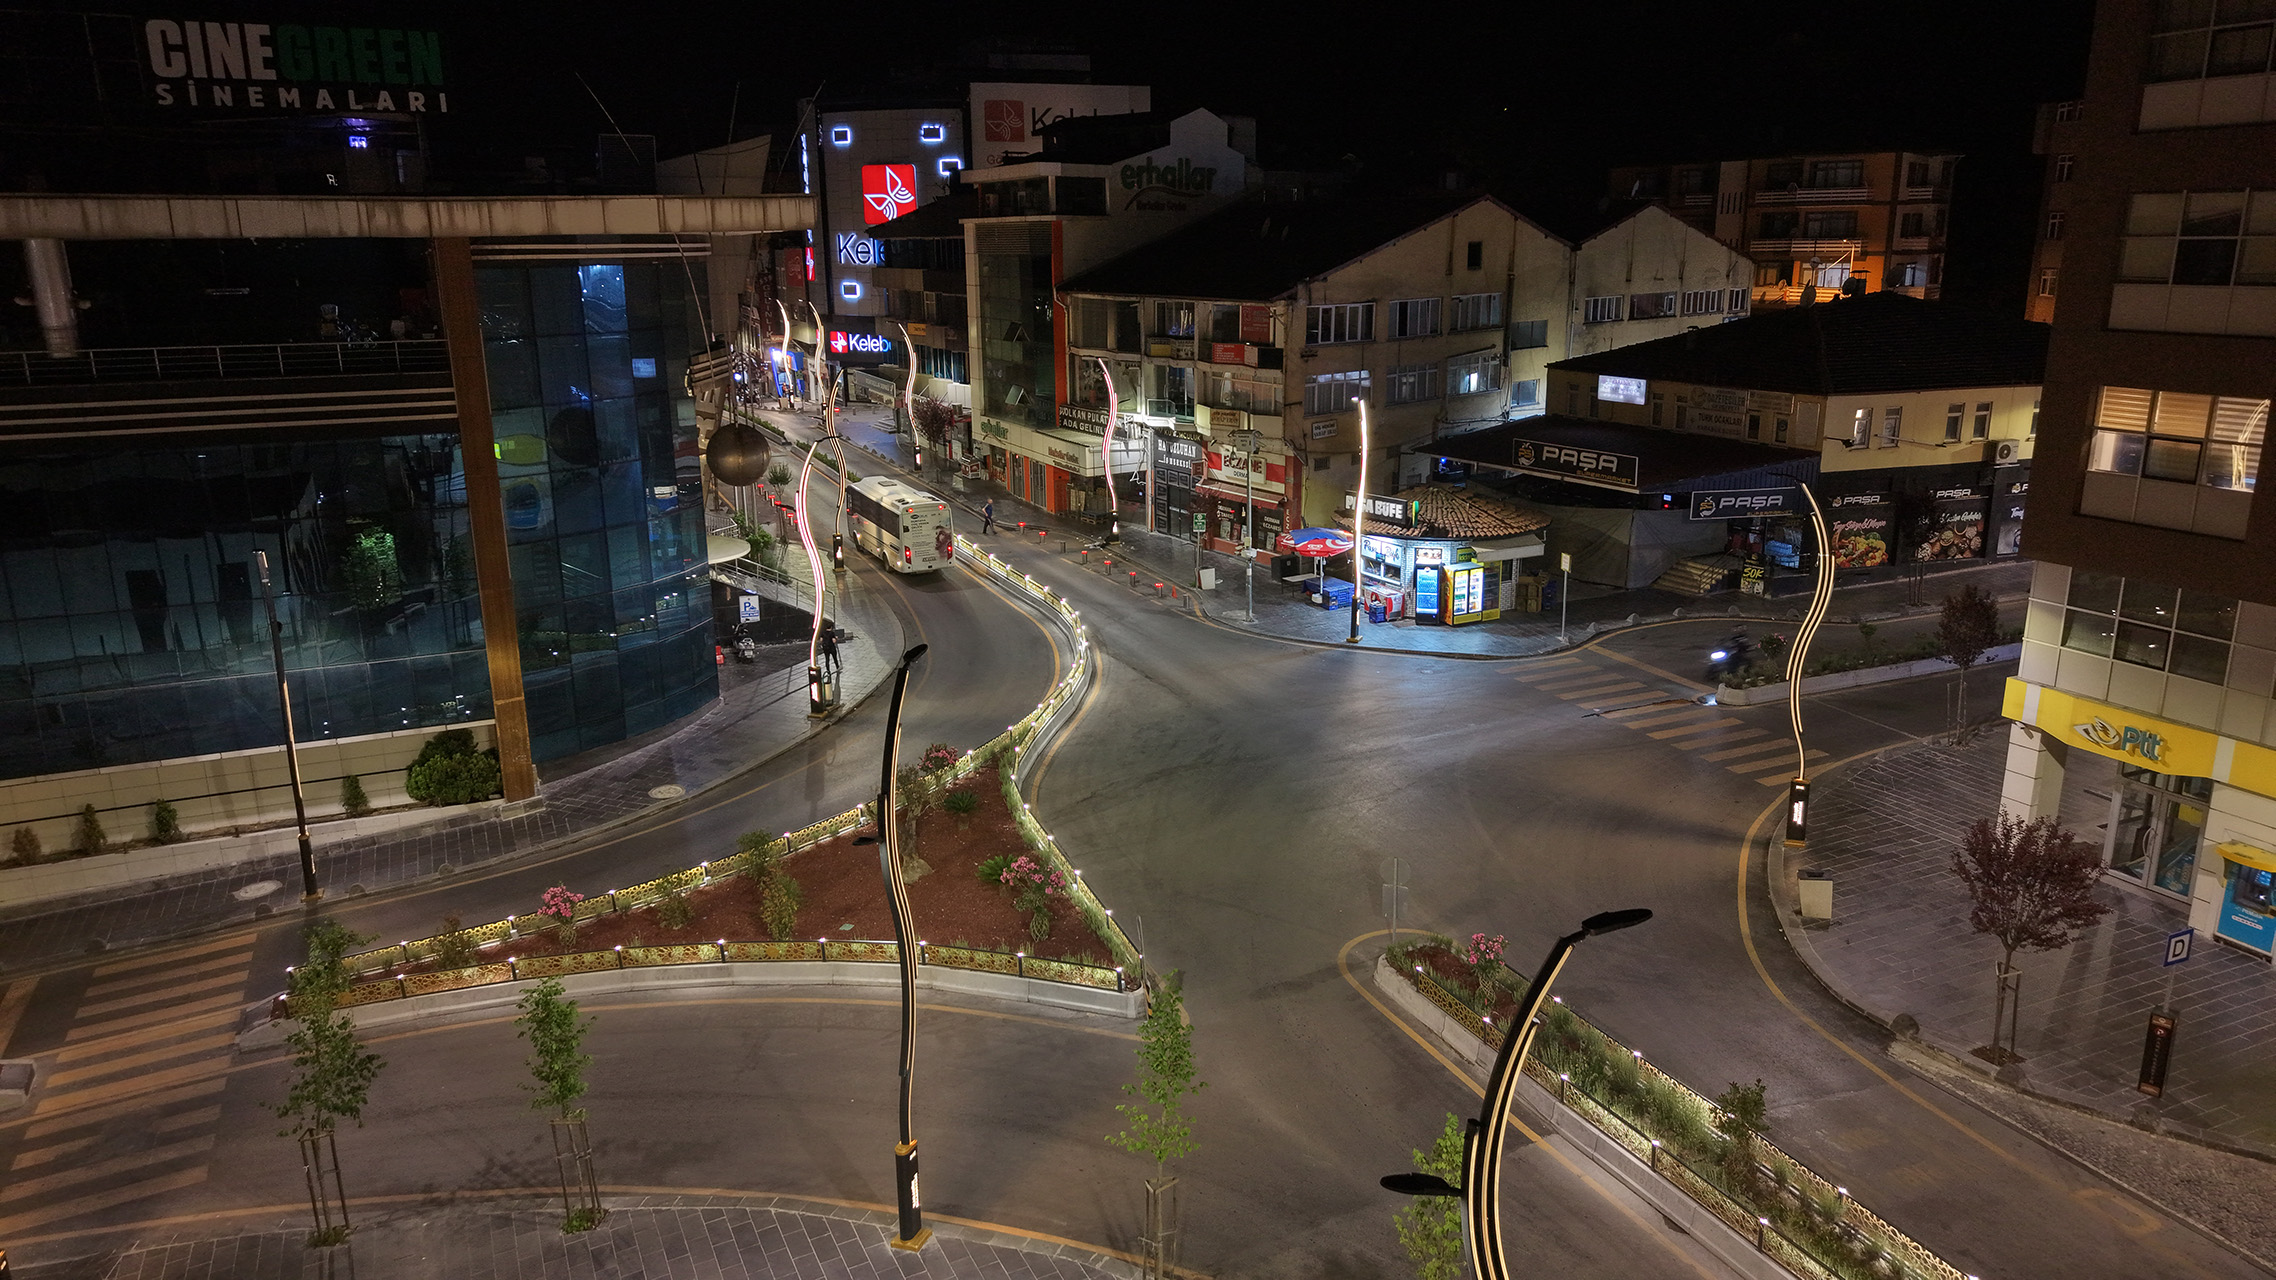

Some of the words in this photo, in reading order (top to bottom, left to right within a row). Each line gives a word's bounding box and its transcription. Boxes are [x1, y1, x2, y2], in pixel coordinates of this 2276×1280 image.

[154, 78, 448, 114] SİNEMALARI
[1541, 445, 1618, 473] PAŞA
[1718, 495, 1784, 510] PAŞA
[1843, 494, 1881, 505] PAŞA
[1936, 488, 1972, 499] PAŞA
[1374, 500, 1404, 520] BÜFE
[2120, 726, 2162, 761] Ptt
[2172, 938, 2185, 959] D
